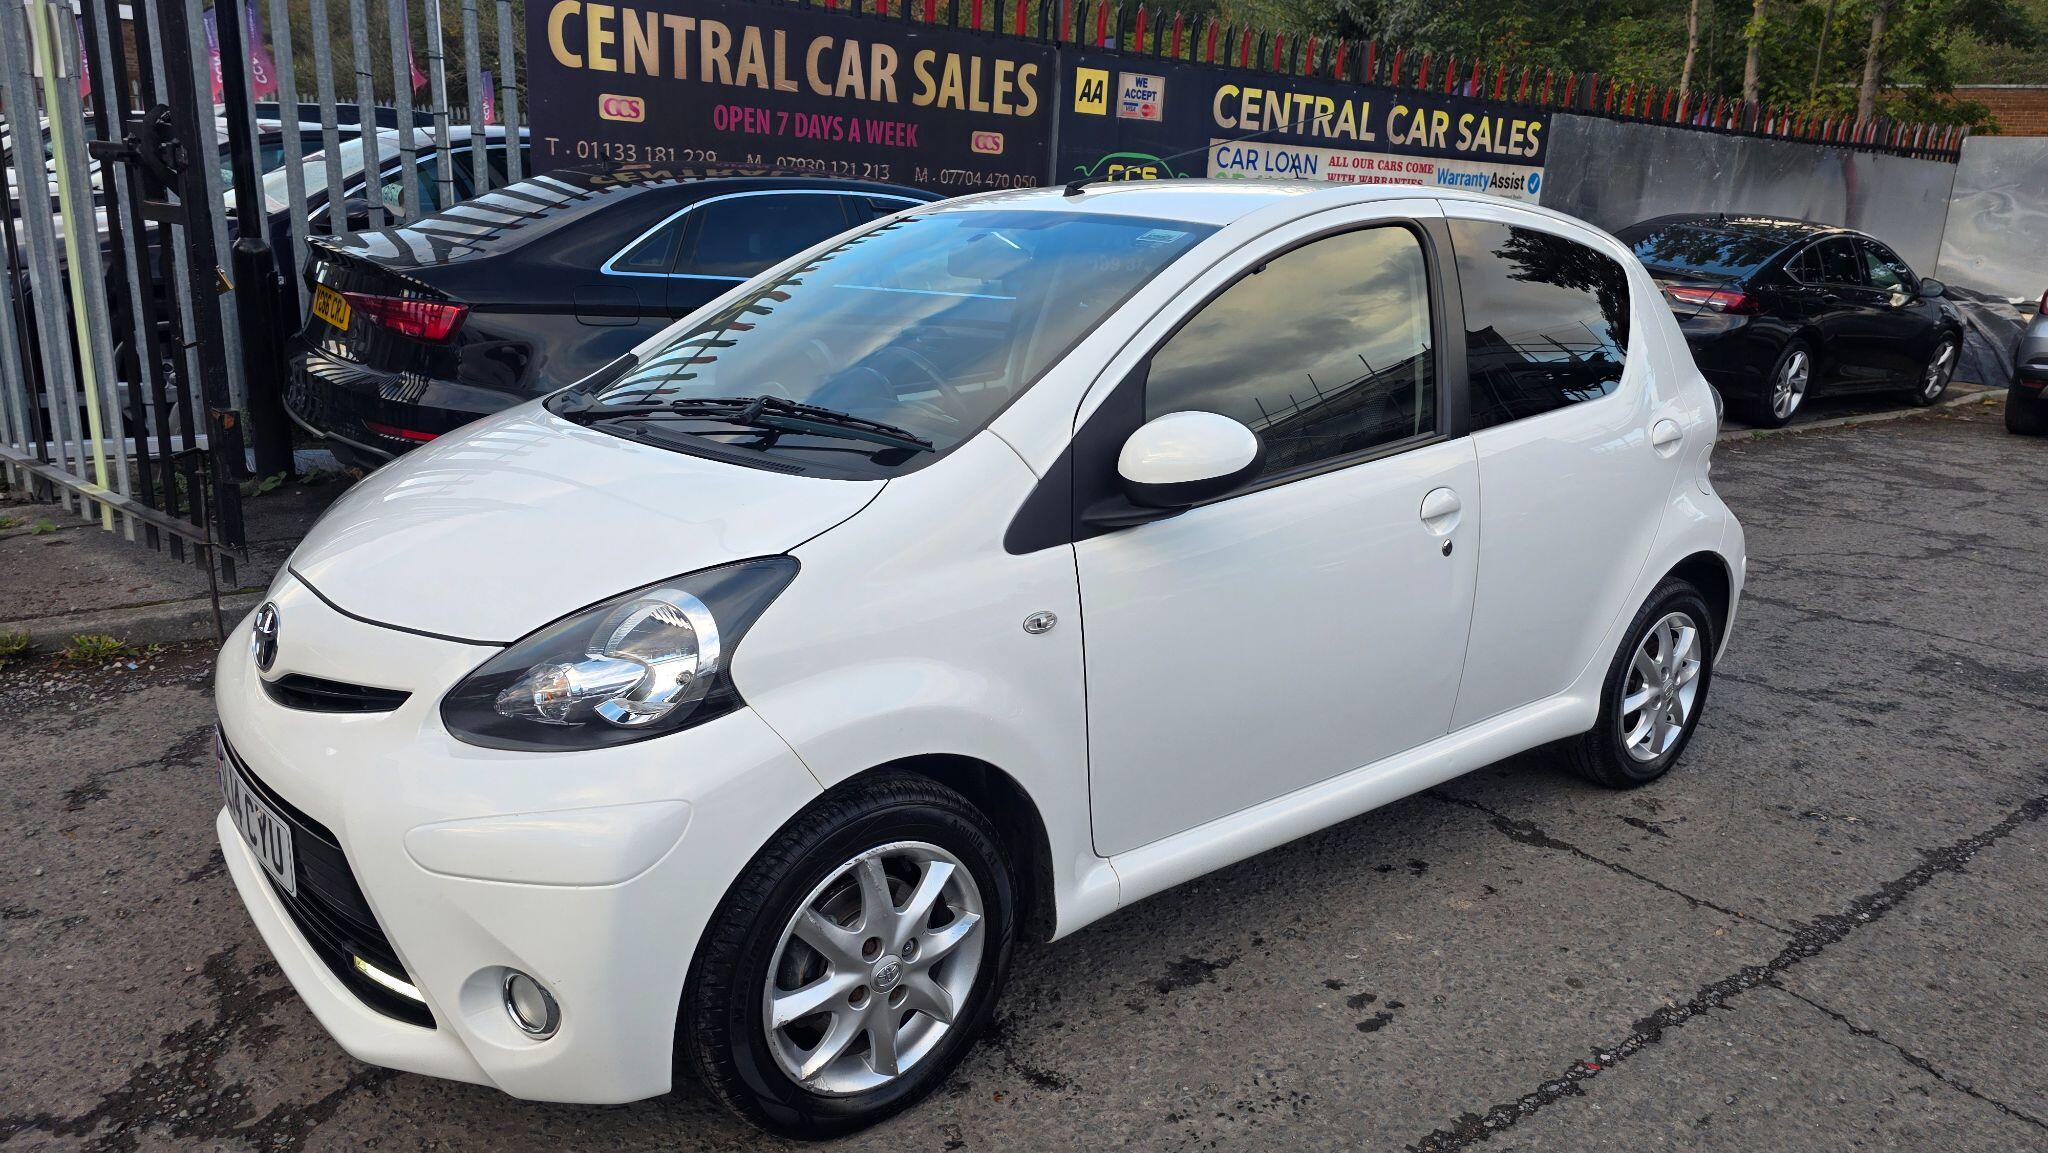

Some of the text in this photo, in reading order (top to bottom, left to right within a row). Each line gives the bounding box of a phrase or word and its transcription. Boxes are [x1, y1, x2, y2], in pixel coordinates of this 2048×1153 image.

[547, 0, 1038, 117] CENTRAL CAR SALES
[1079, 79, 1104, 104] AA
[1135, 77, 1148, 89] WE
[1124, 88, 1157, 102] ACCEPT
[604, 98, 640, 118] CCS
[713, 104, 919, 147] OPEN 7 DAYS A WEEK
[1213, 84, 1541, 158] CENTRAL CAR SALES
[577, 140, 637, 162] 01133
[645, 146, 675, 162] 181
[975, 135, 1000, 151] CCS
[863, 162, 890, 180] 213
[1216, 146, 1318, 175] CAR LOAN
[1328, 155, 1434, 175] ALL OUR CARS COME
[940, 168, 982, 186] 07704
[985, 172, 1010, 188] 470
[1013, 174, 1037, 189] 050
[1327, 172, 1356, 183] WITH
[245, 793, 284, 876] CYU
